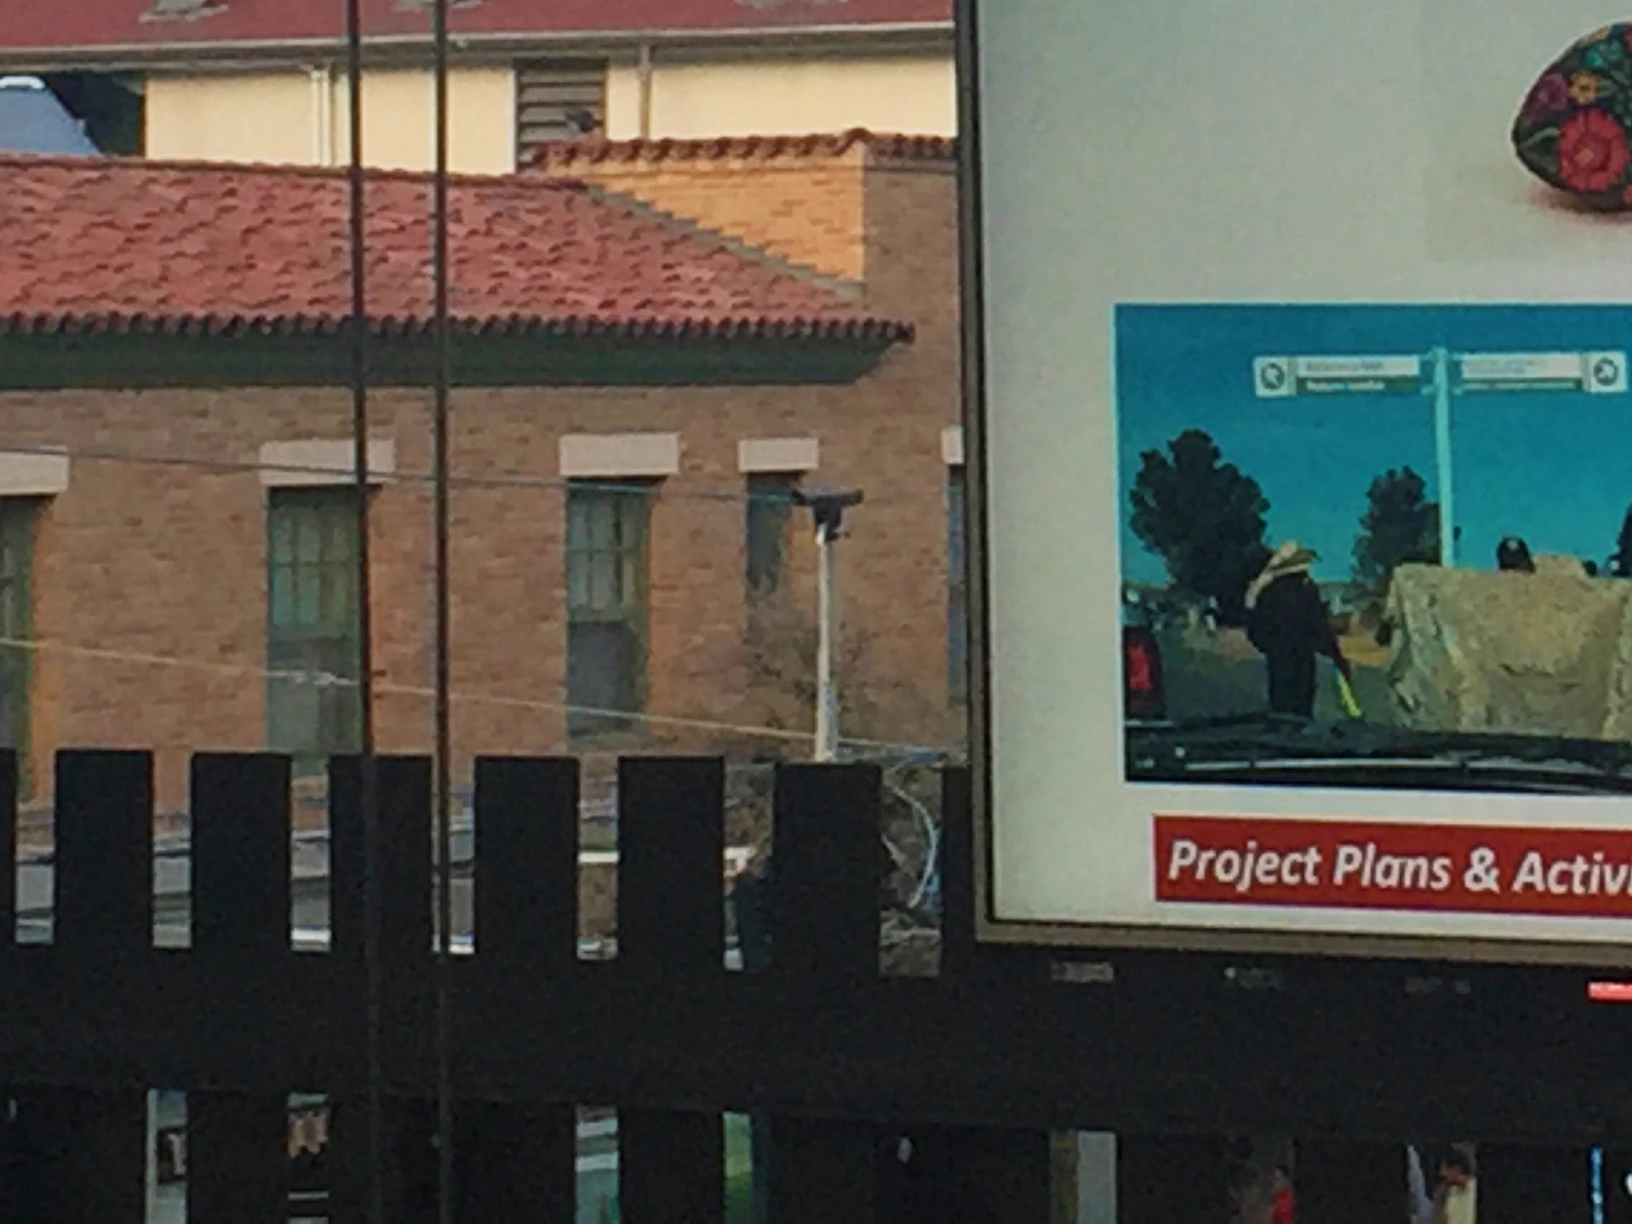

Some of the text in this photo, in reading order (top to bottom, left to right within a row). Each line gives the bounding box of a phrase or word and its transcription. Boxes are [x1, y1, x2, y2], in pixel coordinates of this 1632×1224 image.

[1168, 839, 1321, 894] Project
[1333, 842, 1451, 891] Plans
[1463, 847, 1501, 894] &
